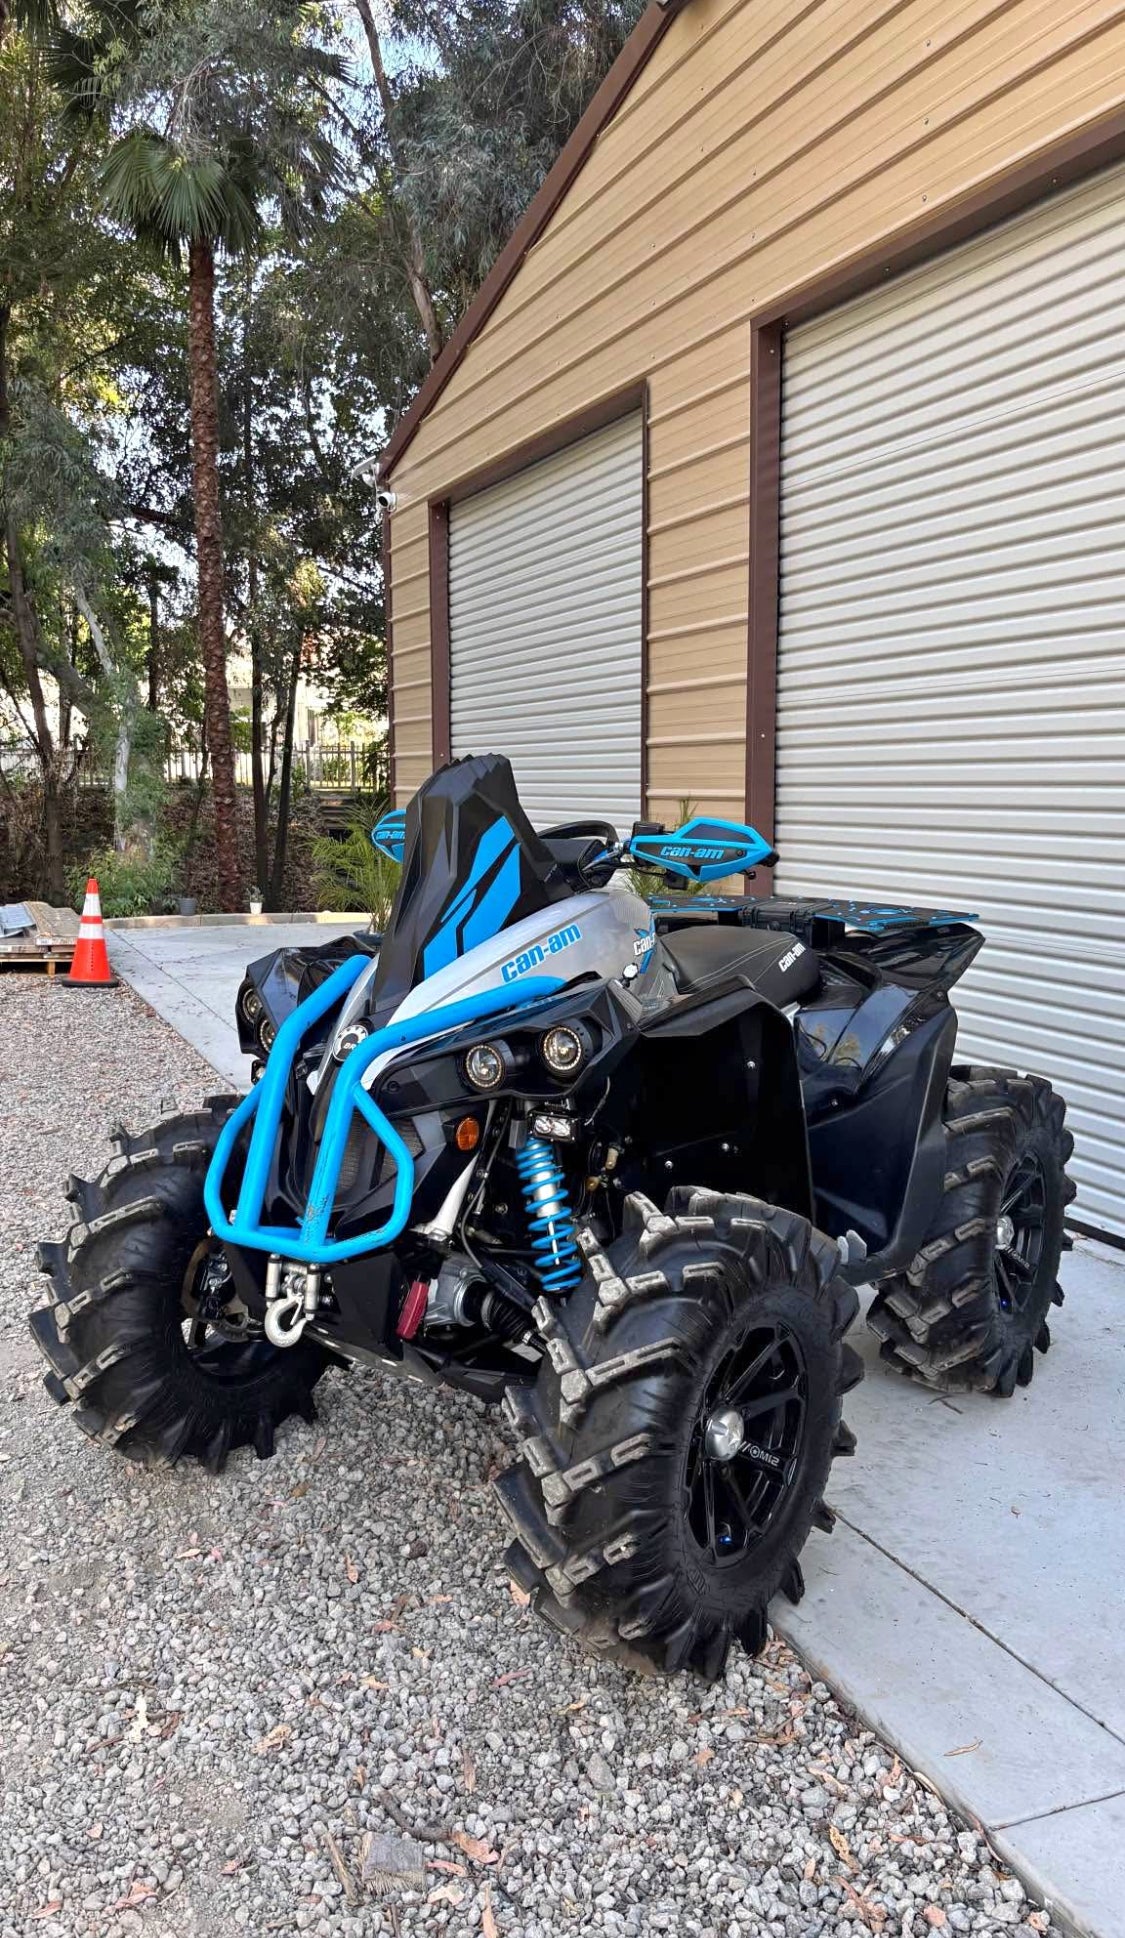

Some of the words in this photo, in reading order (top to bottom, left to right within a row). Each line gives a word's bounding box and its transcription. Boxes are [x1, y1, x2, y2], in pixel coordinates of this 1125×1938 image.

[660, 846, 725, 859] can-am
[501, 923, 581, 982] can-am
[778, 942, 806, 972] can-am
